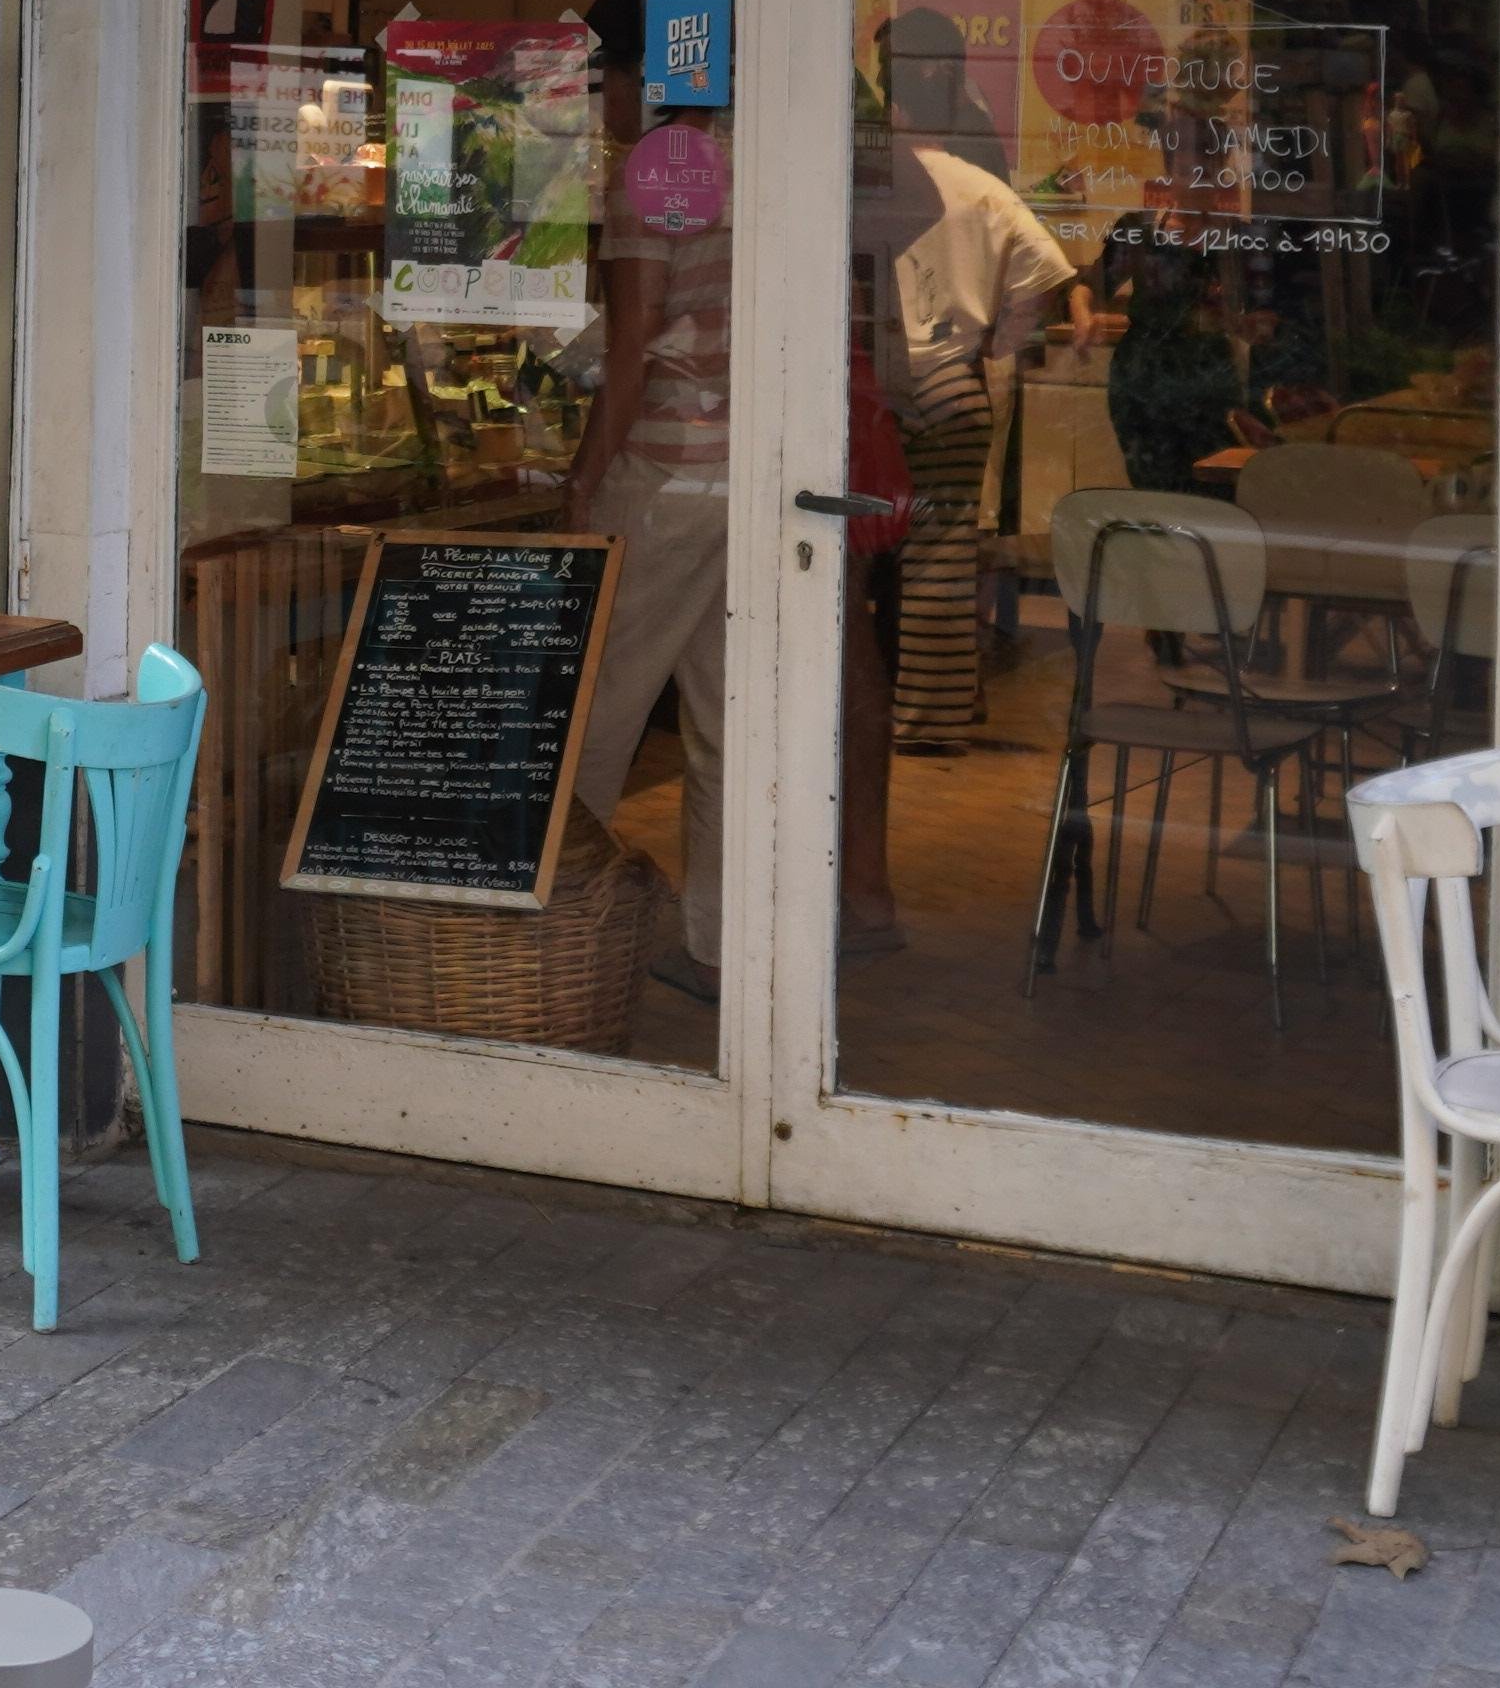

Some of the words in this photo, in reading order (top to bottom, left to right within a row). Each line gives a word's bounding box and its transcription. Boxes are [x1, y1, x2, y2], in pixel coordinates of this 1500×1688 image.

[667, 12, 710, 43] DELI
[667, 38, 710, 68] CITY
[1058, 48, 1281, 93] OUVERTURE
[1047, 118, 1128, 153] MARDI
[1149, 128, 1180, 151] AU
[1204, 115, 1329, 159] SAMEDI
[637, 167, 659, 183] LA
[1152, 227, 1184, 247] DE
[1279, 232, 1303, 253] à
[206, 332, 252, 345] APERO
[421, 547, 438, 561] LA
[444, 547, 481, 563] PÊCHE
[481, 548, 493, 562] À
[496, 551, 509, 562] LA
[515, 548, 552, 564] VIGNE
[475, 568, 484, 579] À
[487, 571, 540, 581] MANGER
[435, 583, 468, 592] NOTRE
[473, 583, 522, 592] FORMULE
[439, 651, 482, 666] PLATS
[362, 831, 411, 844] DESSERT
[414, 836, 432, 846] DU
[434, 837, 468, 847] JOUR
